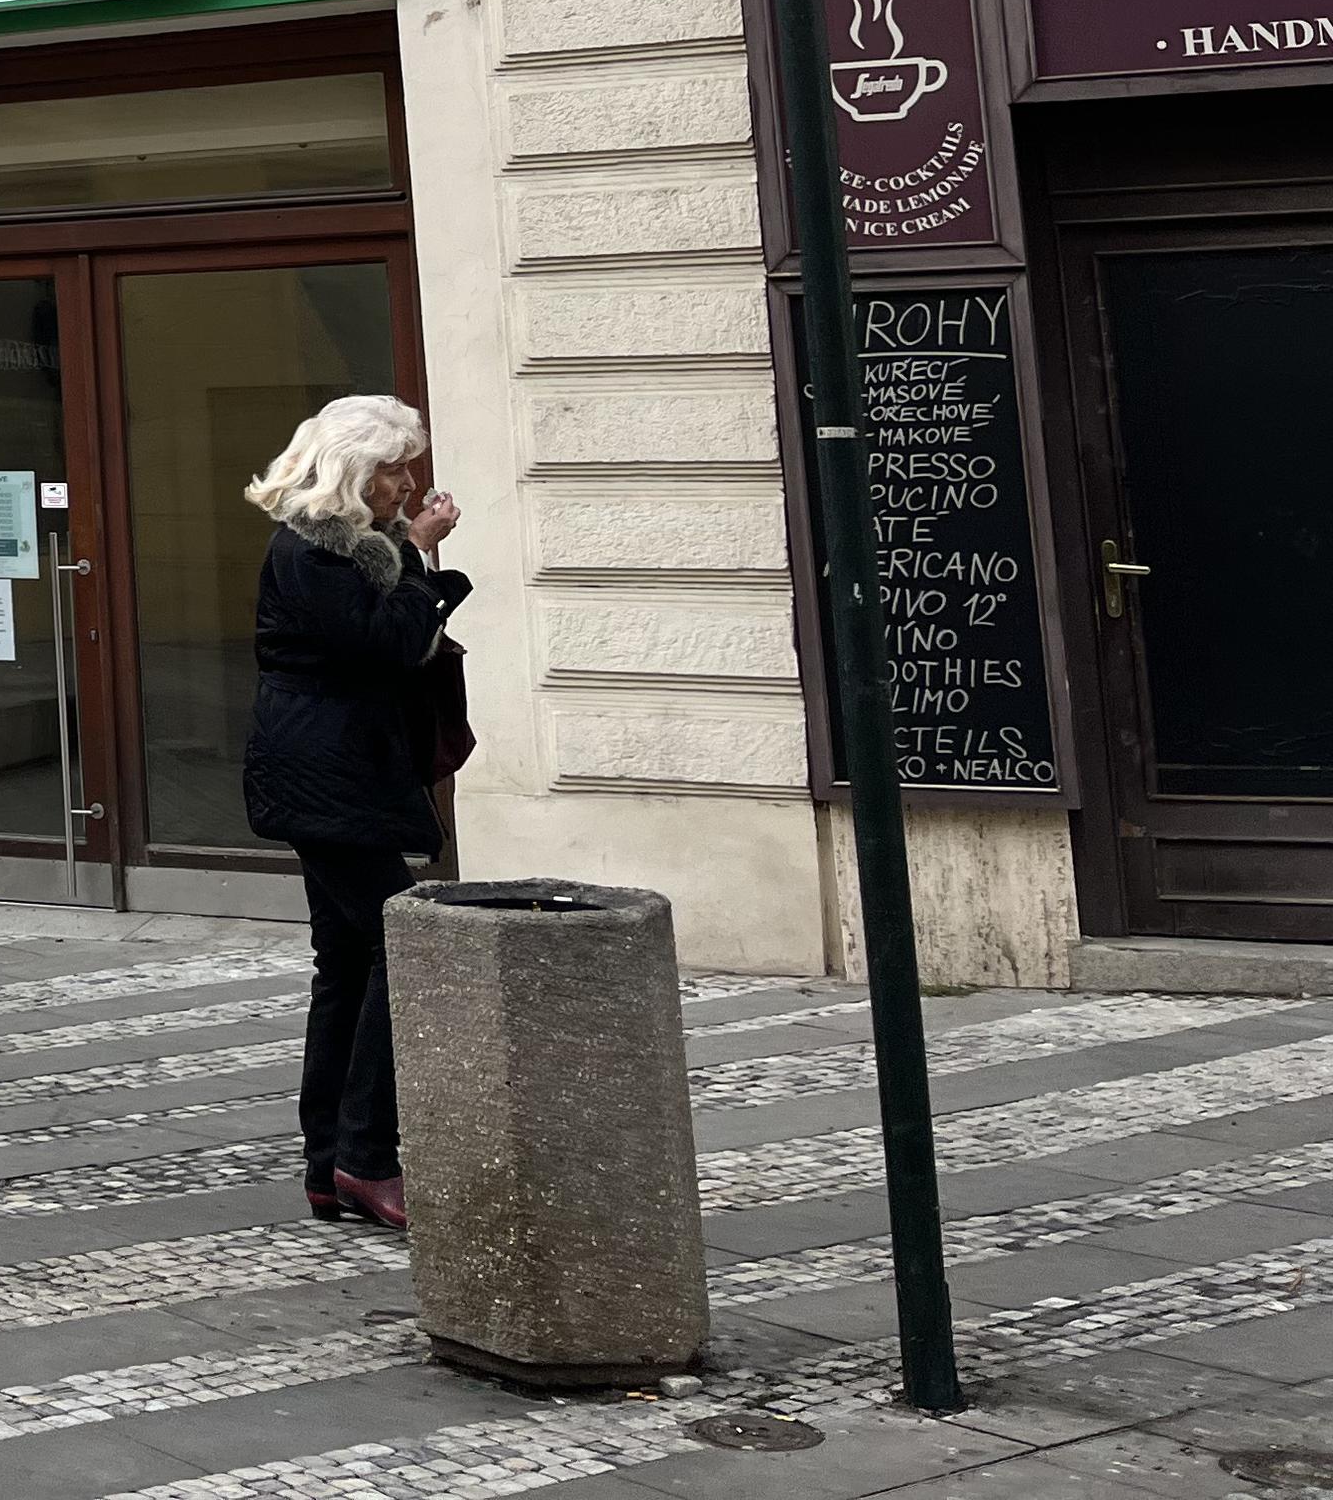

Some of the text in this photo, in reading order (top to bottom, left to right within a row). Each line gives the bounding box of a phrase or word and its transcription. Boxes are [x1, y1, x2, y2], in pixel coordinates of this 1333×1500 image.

[895, 140, 984, 213] LEMONADE
[863, 222, 899, 237] ICE
[901, 197, 972, 235] CREAM
[859, 295, 1006, 348] ROHY
[864, 358, 970, 384] KUŘECÍ
[868, 452, 996, 482] PRESSO
[870, 483, 998, 512] PUCINO
[876, 548, 1018, 586] ERICANO
[887, 657, 1022, 688] OOTHIES
[892, 684, 969, 716] LIMO
[894, 726, 1028, 759] CTEILS
[953, 756, 1055, 783] NEALCO
